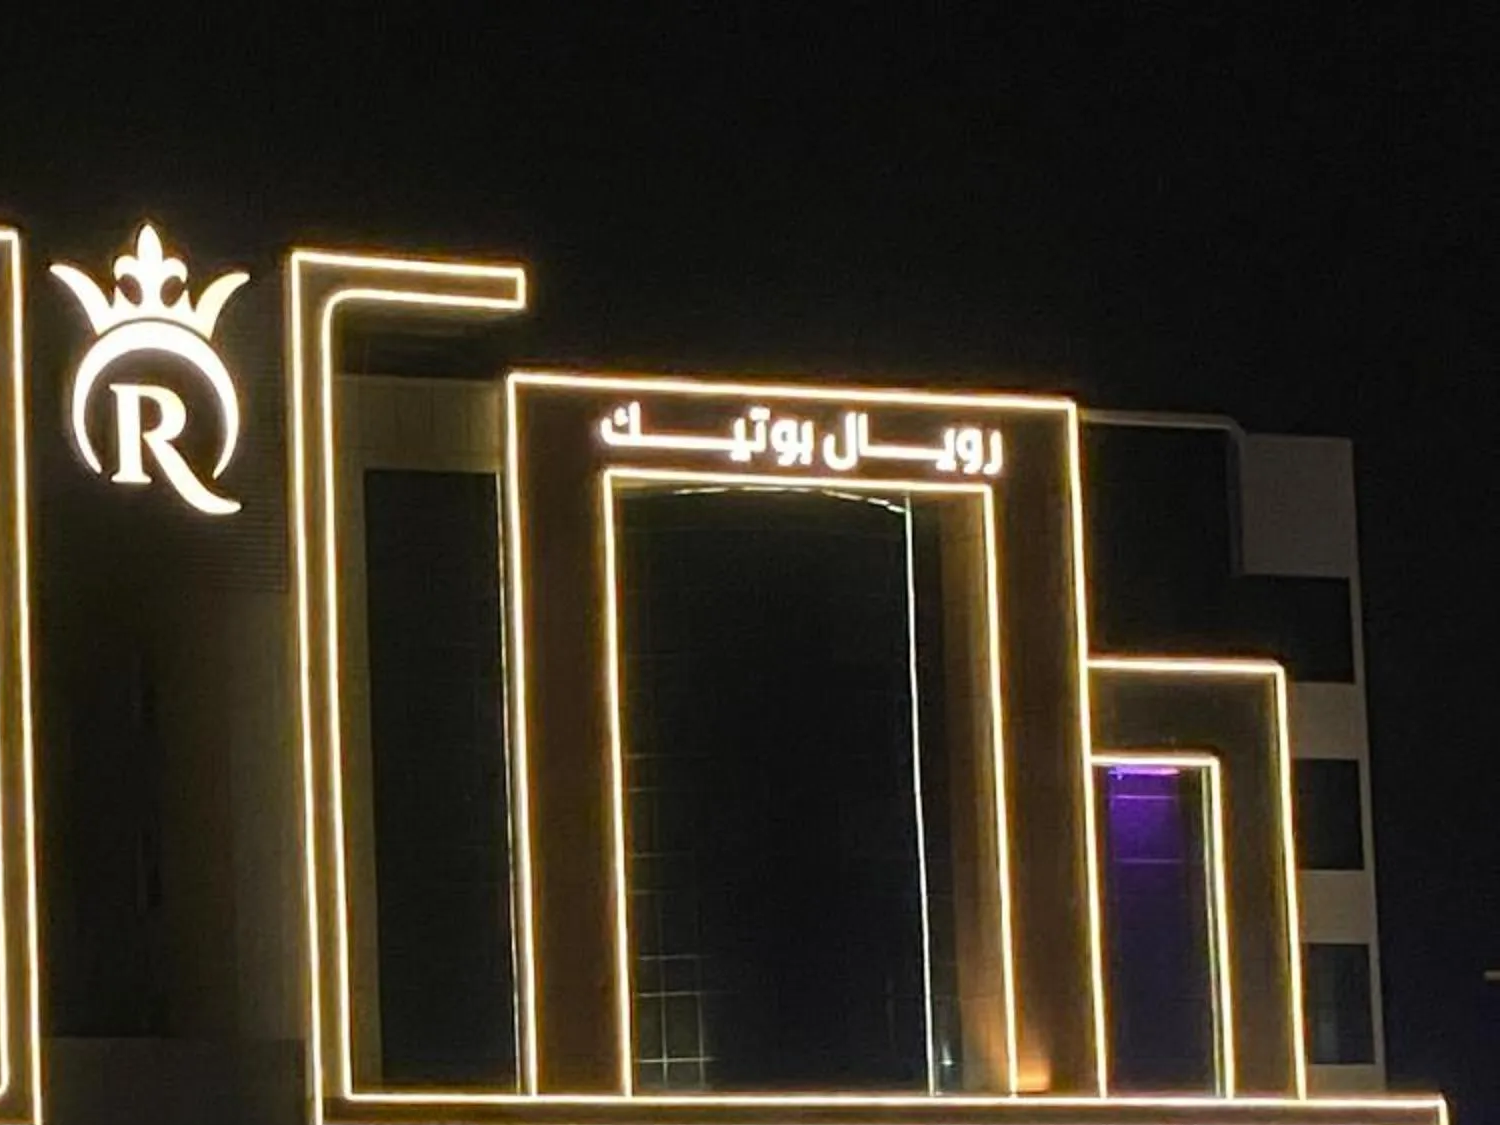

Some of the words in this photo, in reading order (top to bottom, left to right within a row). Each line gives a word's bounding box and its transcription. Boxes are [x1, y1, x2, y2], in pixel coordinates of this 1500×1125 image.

[109, 383, 242, 515] R
[600, 401, 814, 467] بوتيك
[822, 411, 1004, 476] رويال
